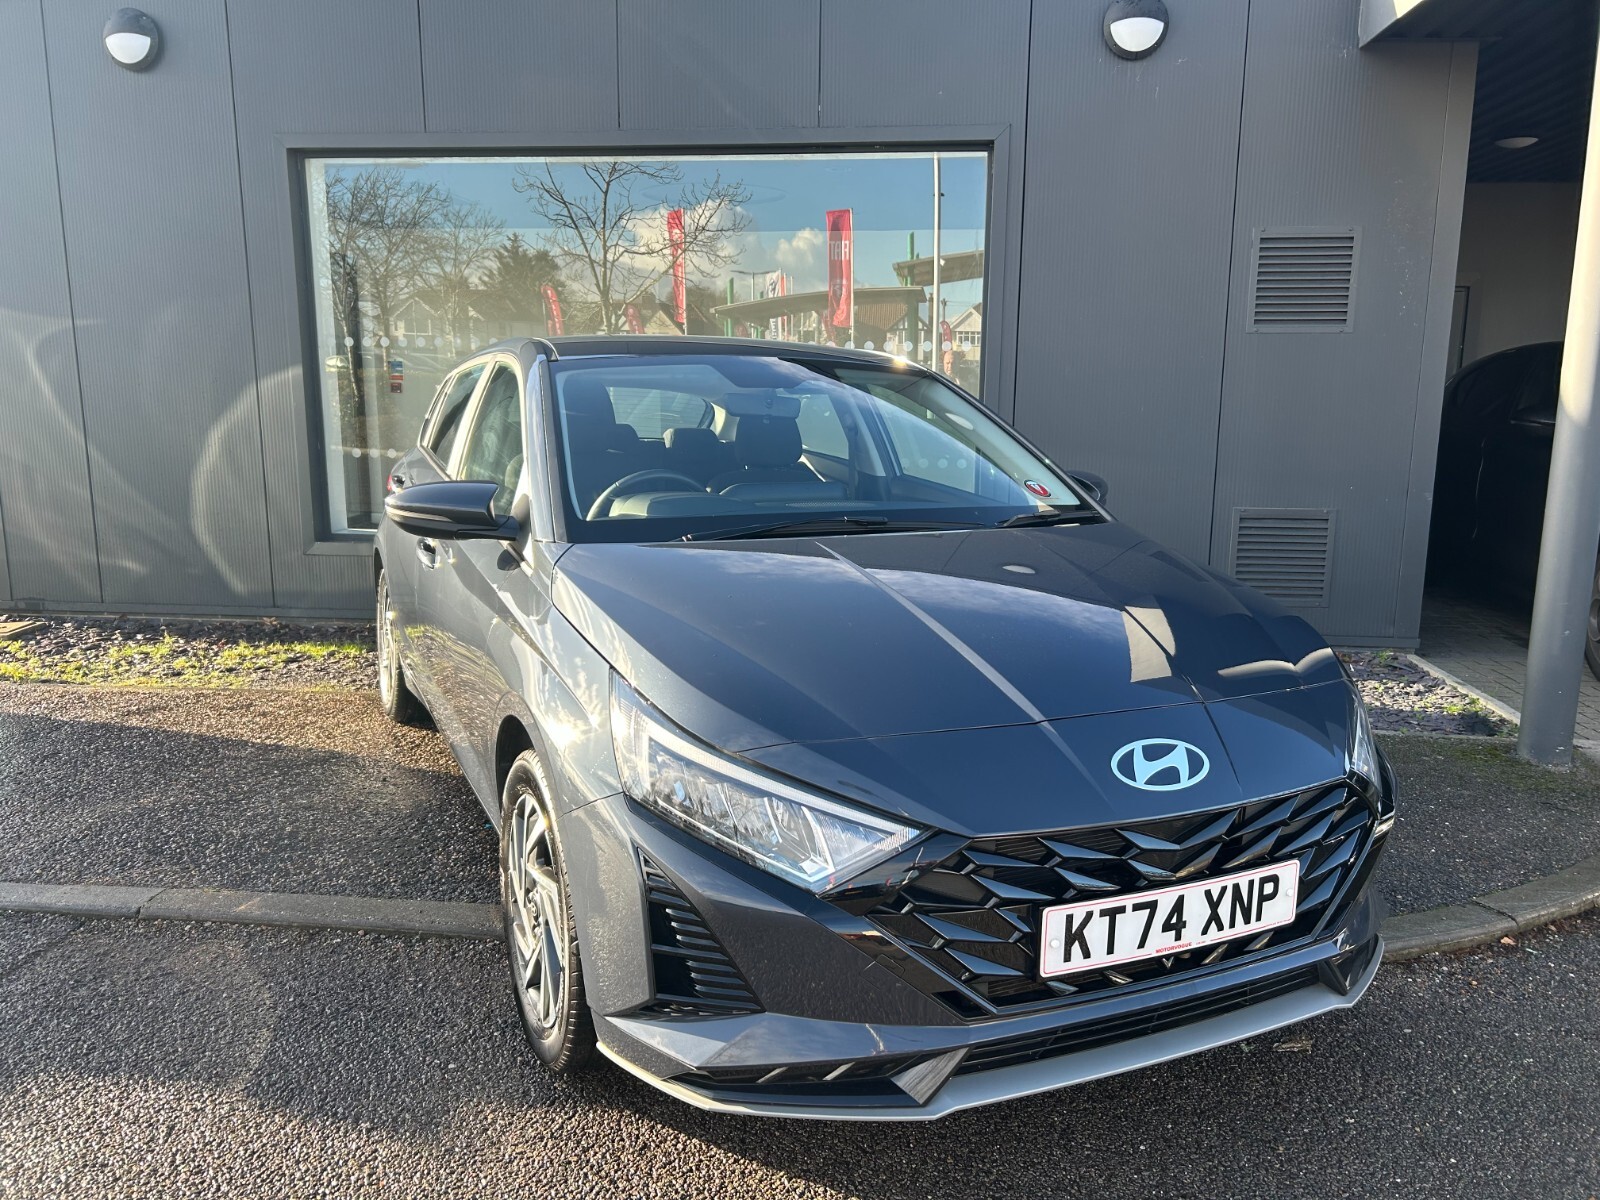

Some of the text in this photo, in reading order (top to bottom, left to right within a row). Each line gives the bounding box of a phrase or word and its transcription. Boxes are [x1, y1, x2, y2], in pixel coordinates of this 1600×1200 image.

[1063, 873, 1280, 963] KT74 XNP
[1155, 941, 1193, 954] MOTORVOGUE
